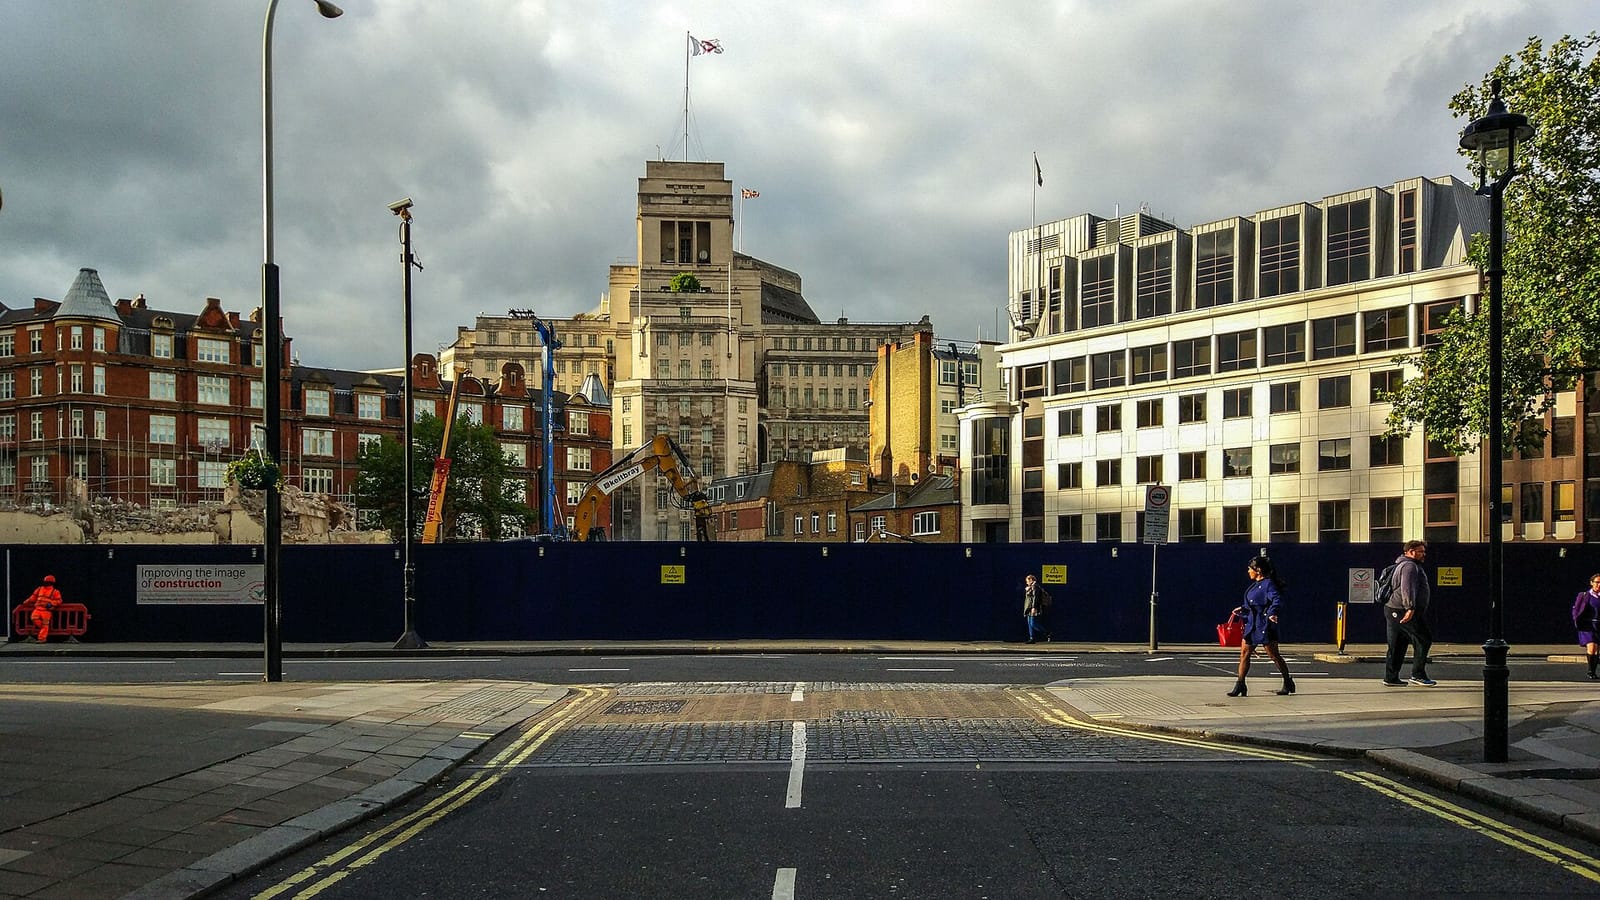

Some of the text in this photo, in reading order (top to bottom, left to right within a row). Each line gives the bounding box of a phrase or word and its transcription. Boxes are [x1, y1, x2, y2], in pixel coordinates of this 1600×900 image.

[608, 466, 640, 486] keltbray
[141, 567, 246, 579] Improving the image
[141, 578, 222, 588] of construction
